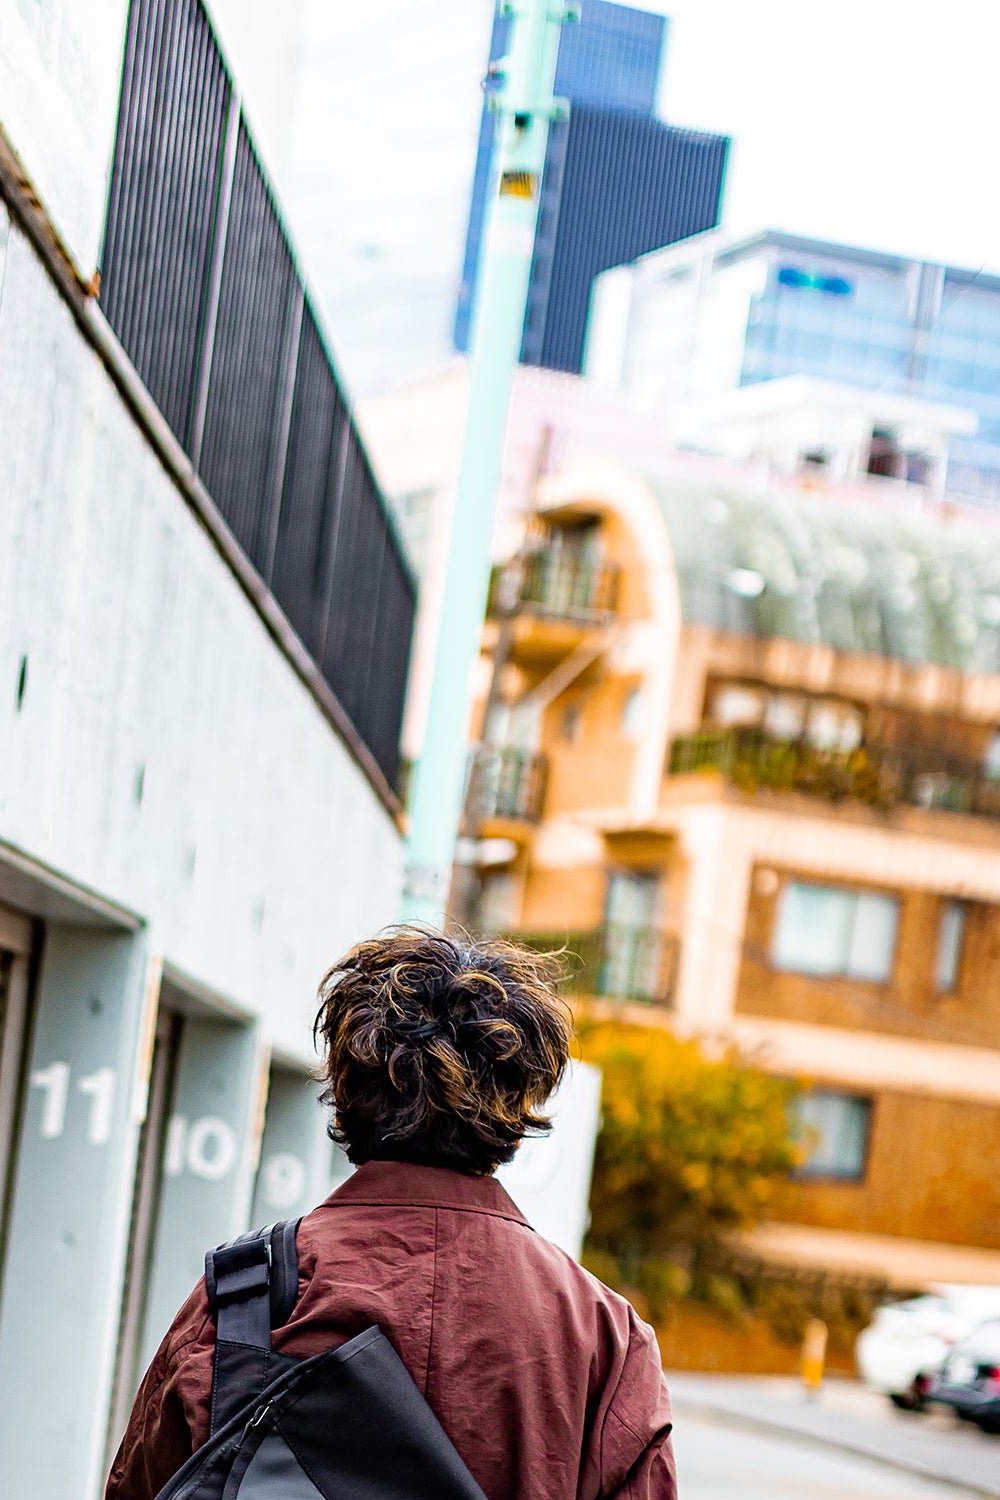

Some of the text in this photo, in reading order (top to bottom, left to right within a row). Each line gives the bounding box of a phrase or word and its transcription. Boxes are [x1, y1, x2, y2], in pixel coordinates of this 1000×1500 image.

[31, 1062, 118, 1145] 11
[166, 1115, 235, 1178] 10
[264, 1152, 305, 1206] 9
